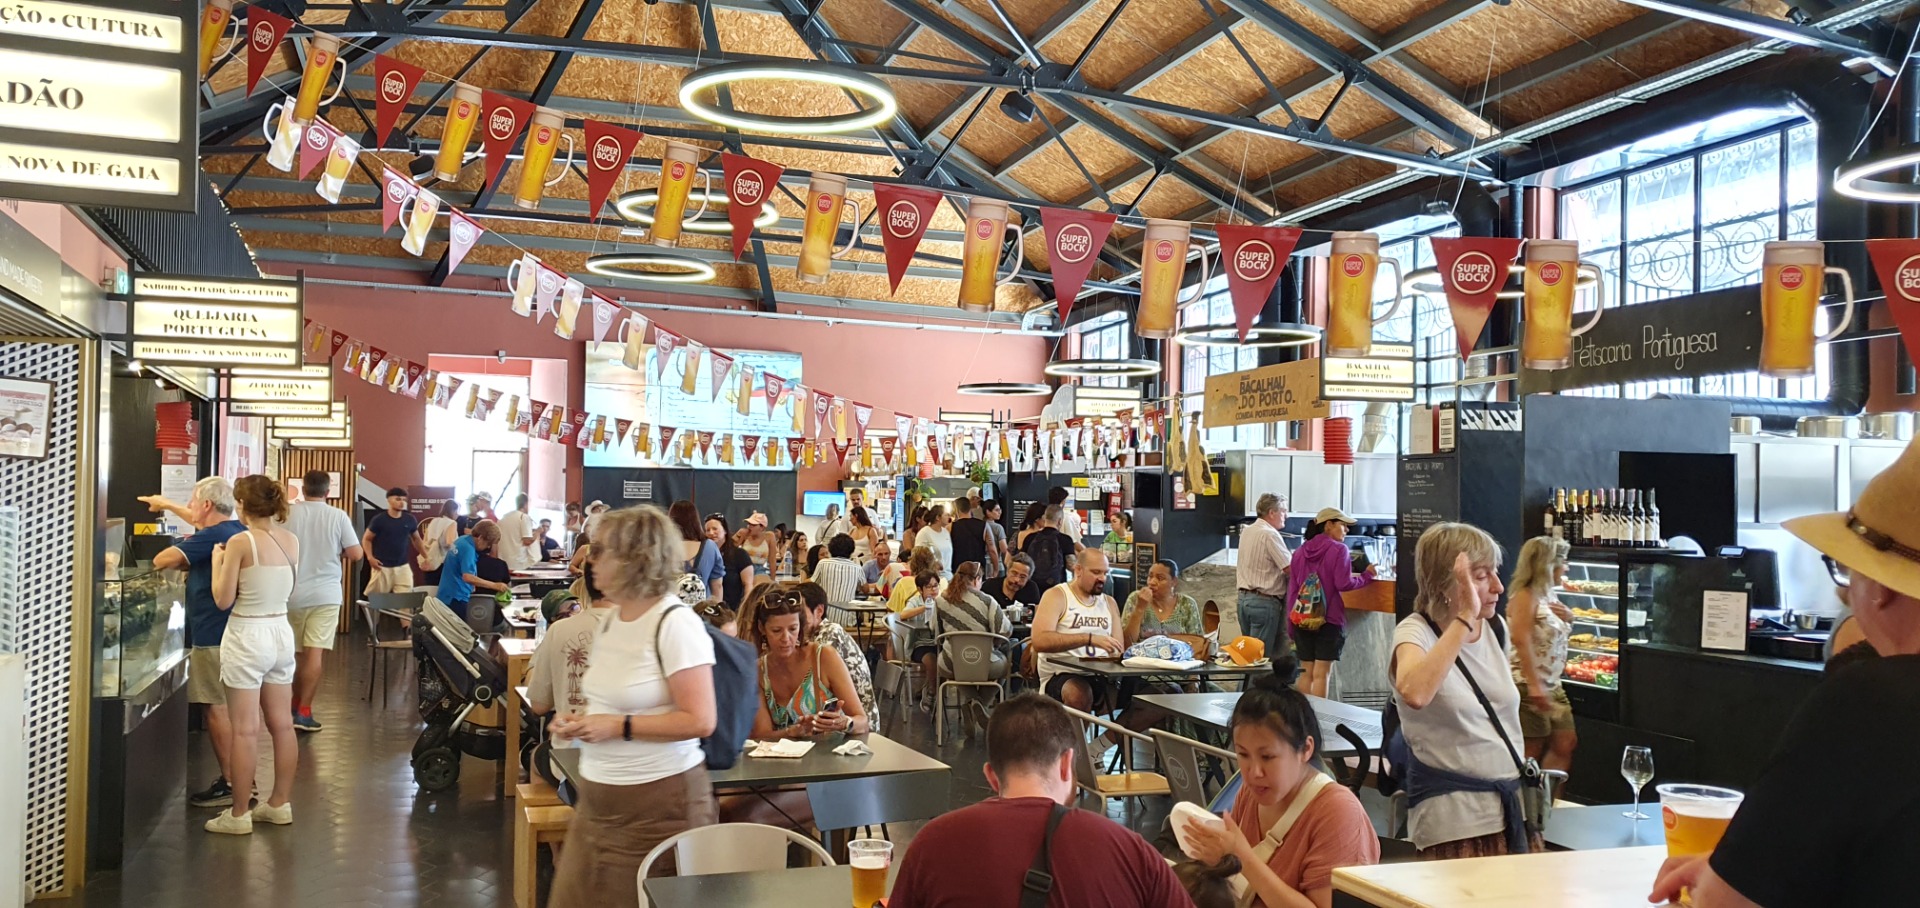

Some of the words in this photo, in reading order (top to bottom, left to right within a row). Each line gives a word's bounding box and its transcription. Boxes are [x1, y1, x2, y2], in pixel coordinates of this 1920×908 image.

[61, 14, 164, 38] CULTURA
[256, 28, 272, 38] SUPER
[255, 33, 270, 45] BOCK
[385, 78, 404, 89] SUPER
[0, 78, 84, 110] DÃO
[384, 84, 401, 96] BOCK
[492, 114, 512, 126] SUPER
[492, 122, 510, 133] BOCK
[597, 144, 618, 156] SUPER
[596, 152, 616, 163] BOCK
[8, 155, 66, 174] NOVA
[72, 160, 102, 176] DE
[106, 164, 160, 181] GAIA
[737, 178, 760, 190] SUPER
[737, 186, 758, 197] BOCK
[892, 209, 916, 220] SUPER
[892, 218, 914, 229] BOCK
[1060, 234, 1088, 244] SUPER
[1061, 243, 1086, 252] BOCK
[1239, 251, 1270, 262] SUPER
[1239, 260, 1267, 270] BOCK
[1456, 263, 1490, 273] SUPER
[1457, 273, 1488, 282] BOCK
[143, 283, 186, 292] SABORES
[174, 309, 258, 323] QUEIJARIA
[164, 324, 267, 338] PORTUGUESA
[1572, 334, 1632, 368] Petiscaria
[1642, 325, 1718, 370] Portuguesa
[1239, 375, 1286, 395] BACALHAU
[1235, 411, 1254, 420] COMIDA
[1069, 613, 1109, 629] LAKERS
